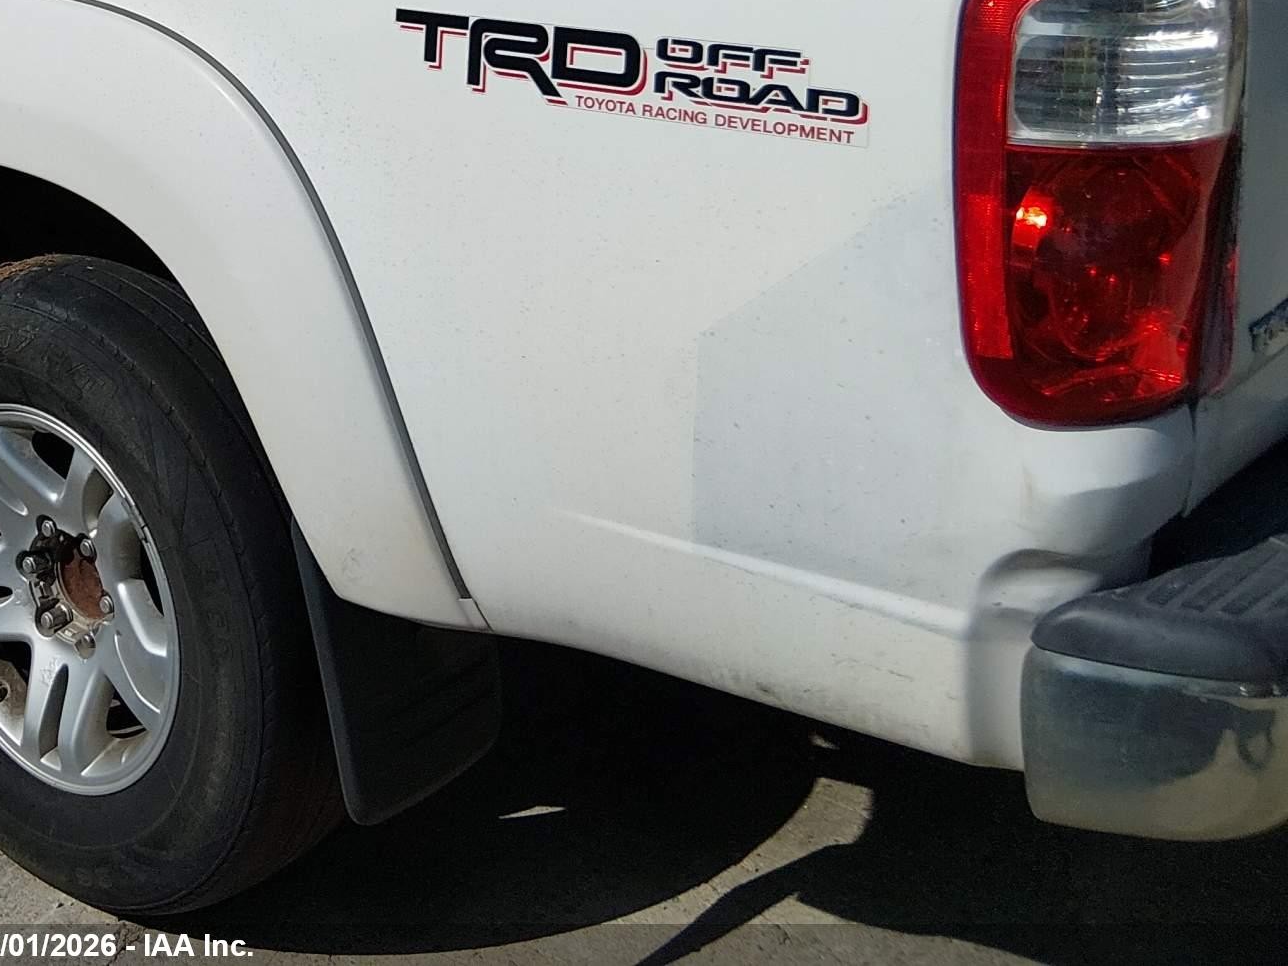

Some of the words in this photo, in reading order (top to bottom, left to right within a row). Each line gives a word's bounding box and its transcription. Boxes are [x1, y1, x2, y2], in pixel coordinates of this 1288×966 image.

[395, 7, 647, 105] TRD
[655, 37, 809, 78] OFF
[575, 95, 636, 116] TOYOTA
[642, 104, 708, 125] RACING
[714, 113, 855, 144] DEVELOPMENT
[653, 70, 870, 125] ROAD
